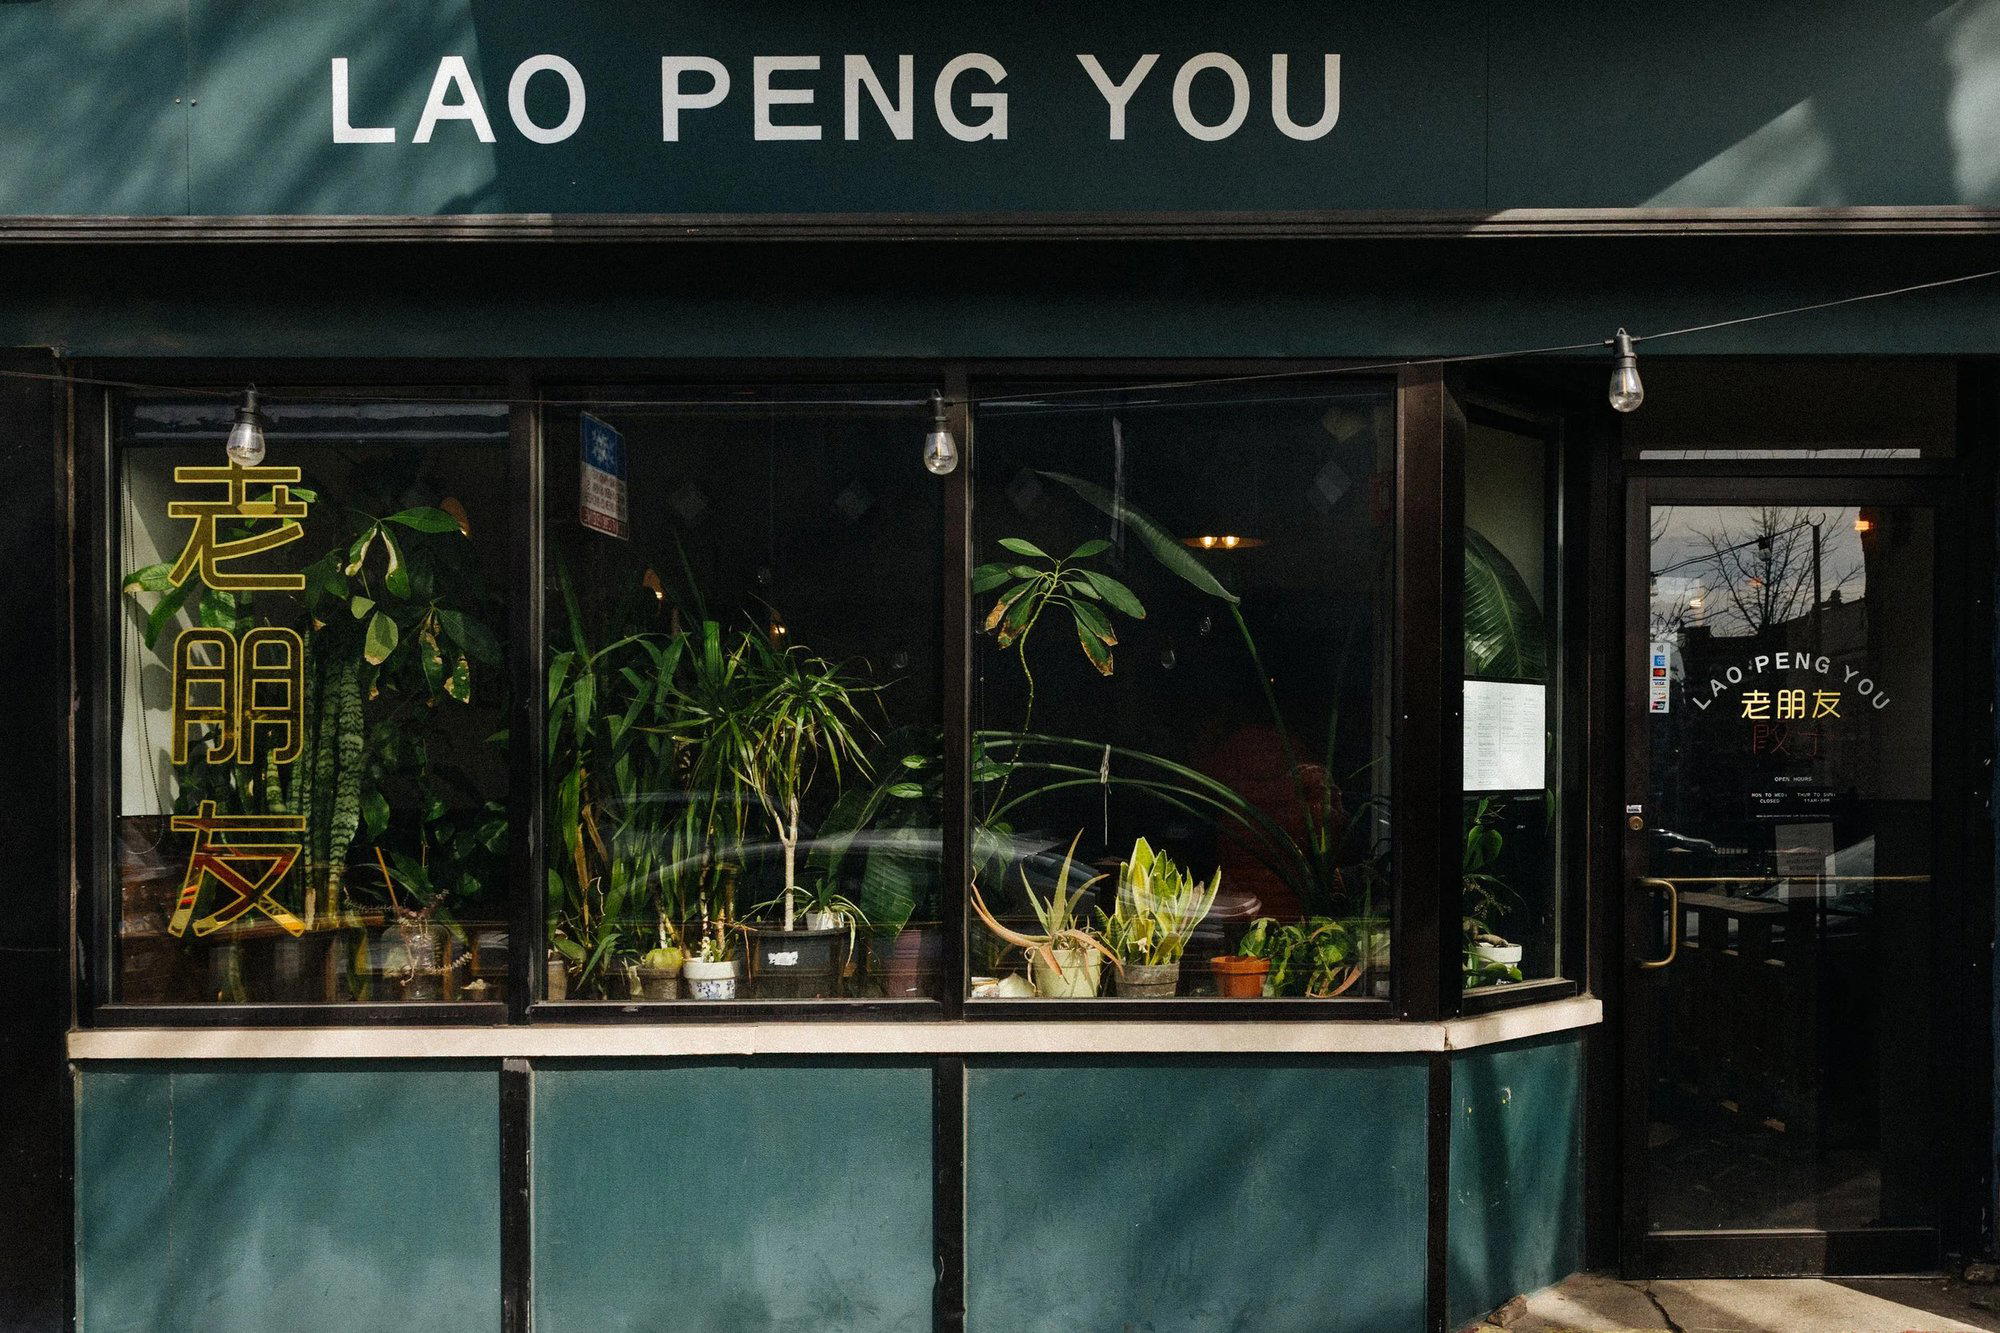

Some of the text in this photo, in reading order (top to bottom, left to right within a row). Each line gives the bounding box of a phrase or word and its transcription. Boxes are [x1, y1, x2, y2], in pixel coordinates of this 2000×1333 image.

[331, 52, 1342, 144] LAO PENG YOU
[168, 459, 308, 938] 老朋友
[1692, 652, 1891, 710] LAO PENG YOU
[1741, 689, 1842, 720] 老朋友
